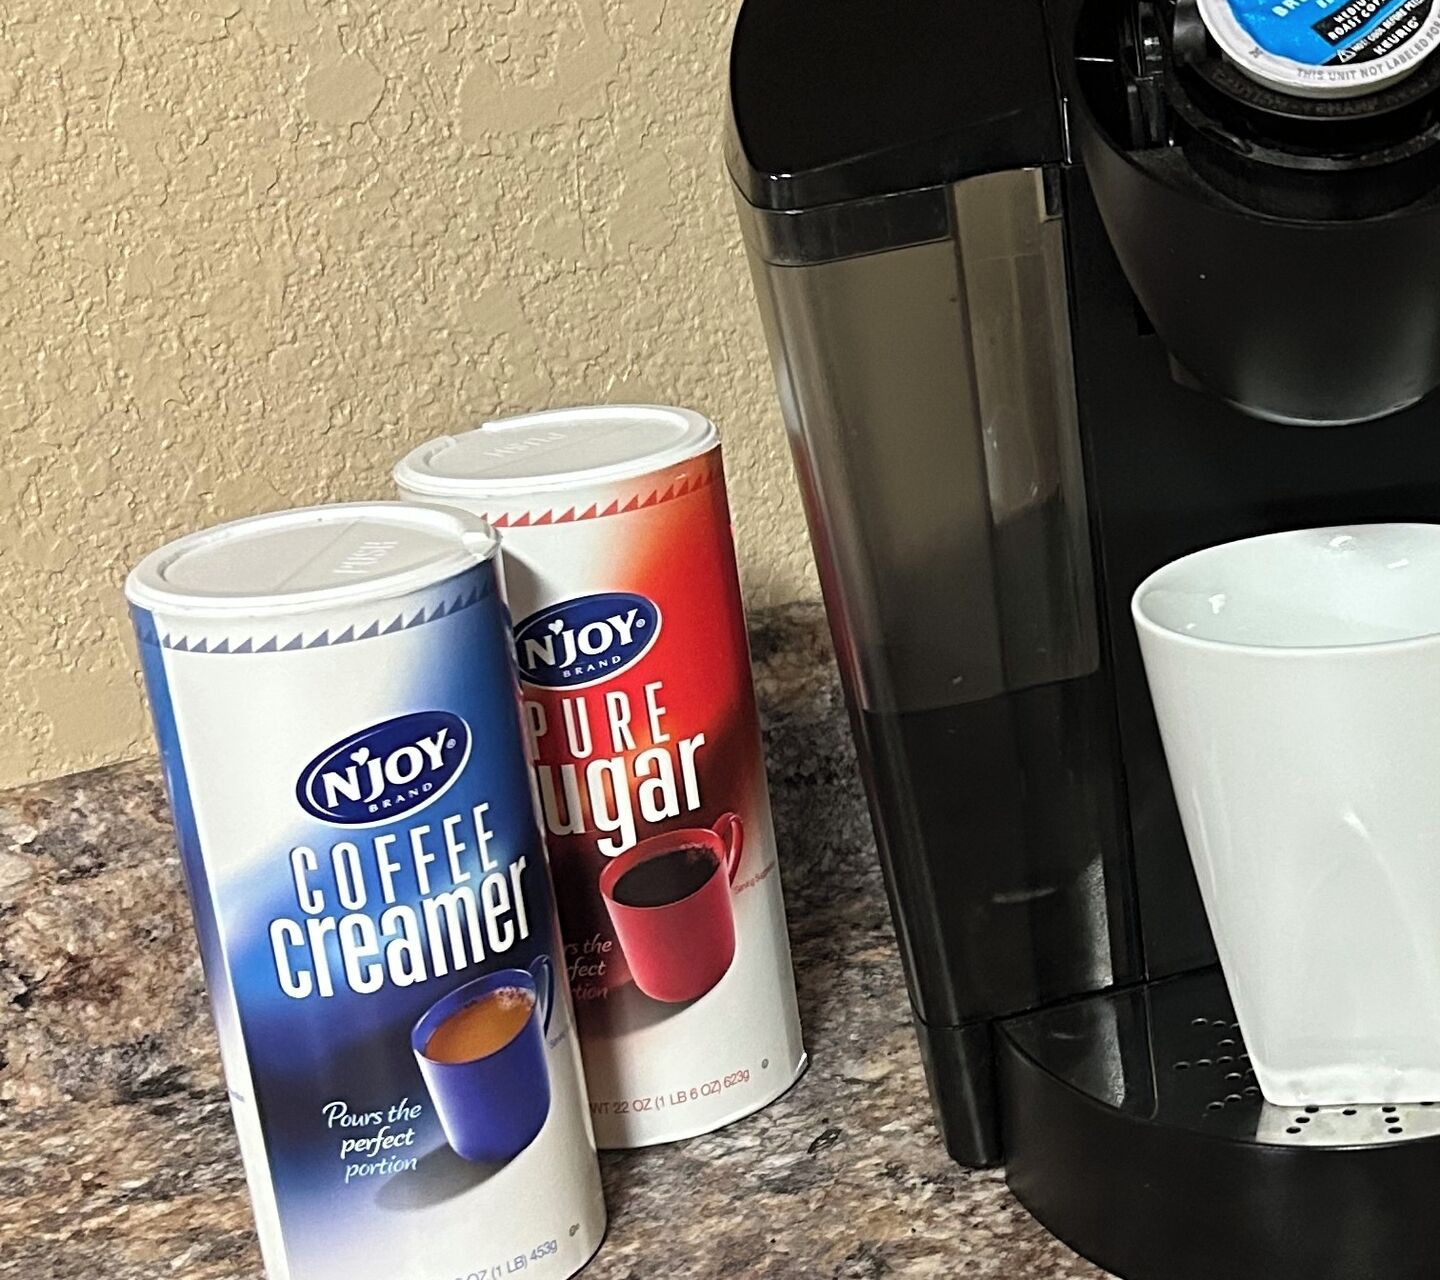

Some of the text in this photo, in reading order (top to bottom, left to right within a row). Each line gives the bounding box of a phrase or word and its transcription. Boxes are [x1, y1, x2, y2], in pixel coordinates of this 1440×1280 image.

[1328, 15, 1362, 40] ROAST
[1373, 17, 1420, 55] KEURIG
[1297, 67, 1323, 80] THIS
[1328, 70, 1357, 81] UNIT
[1360, 64, 1383, 79] NOT
[1385, 38, 1429, 70] LABELED
[563, 655, 621, 677] BRAND
[523, 681, 670, 761] PURE
[369, 782, 433, 813] BRAND
[537, 733, 705, 857] ugar
[290, 802, 498, 915] COFFEE
[270, 855, 529, 999] creamer
[583, 933, 612, 954] the
[613, 1102, 630, 1114] 22
[632, 1098, 652, 1112] OZ
[655, 1096, 665, 1111] (1
[670, 1091, 687, 1105] LB
[690, 1088, 698, 1100] 6
[701, 1080, 722, 1096] OZ)
[724, 1070, 750, 1087] 623g
[322, 1097, 422, 1128] Pours the
[340, 1125, 415, 1159] perfect
[345, 1155, 418, 1184] portion
[506, 1254, 529, 1273] LB)
[530, 1239, 558, 1261] 453g
